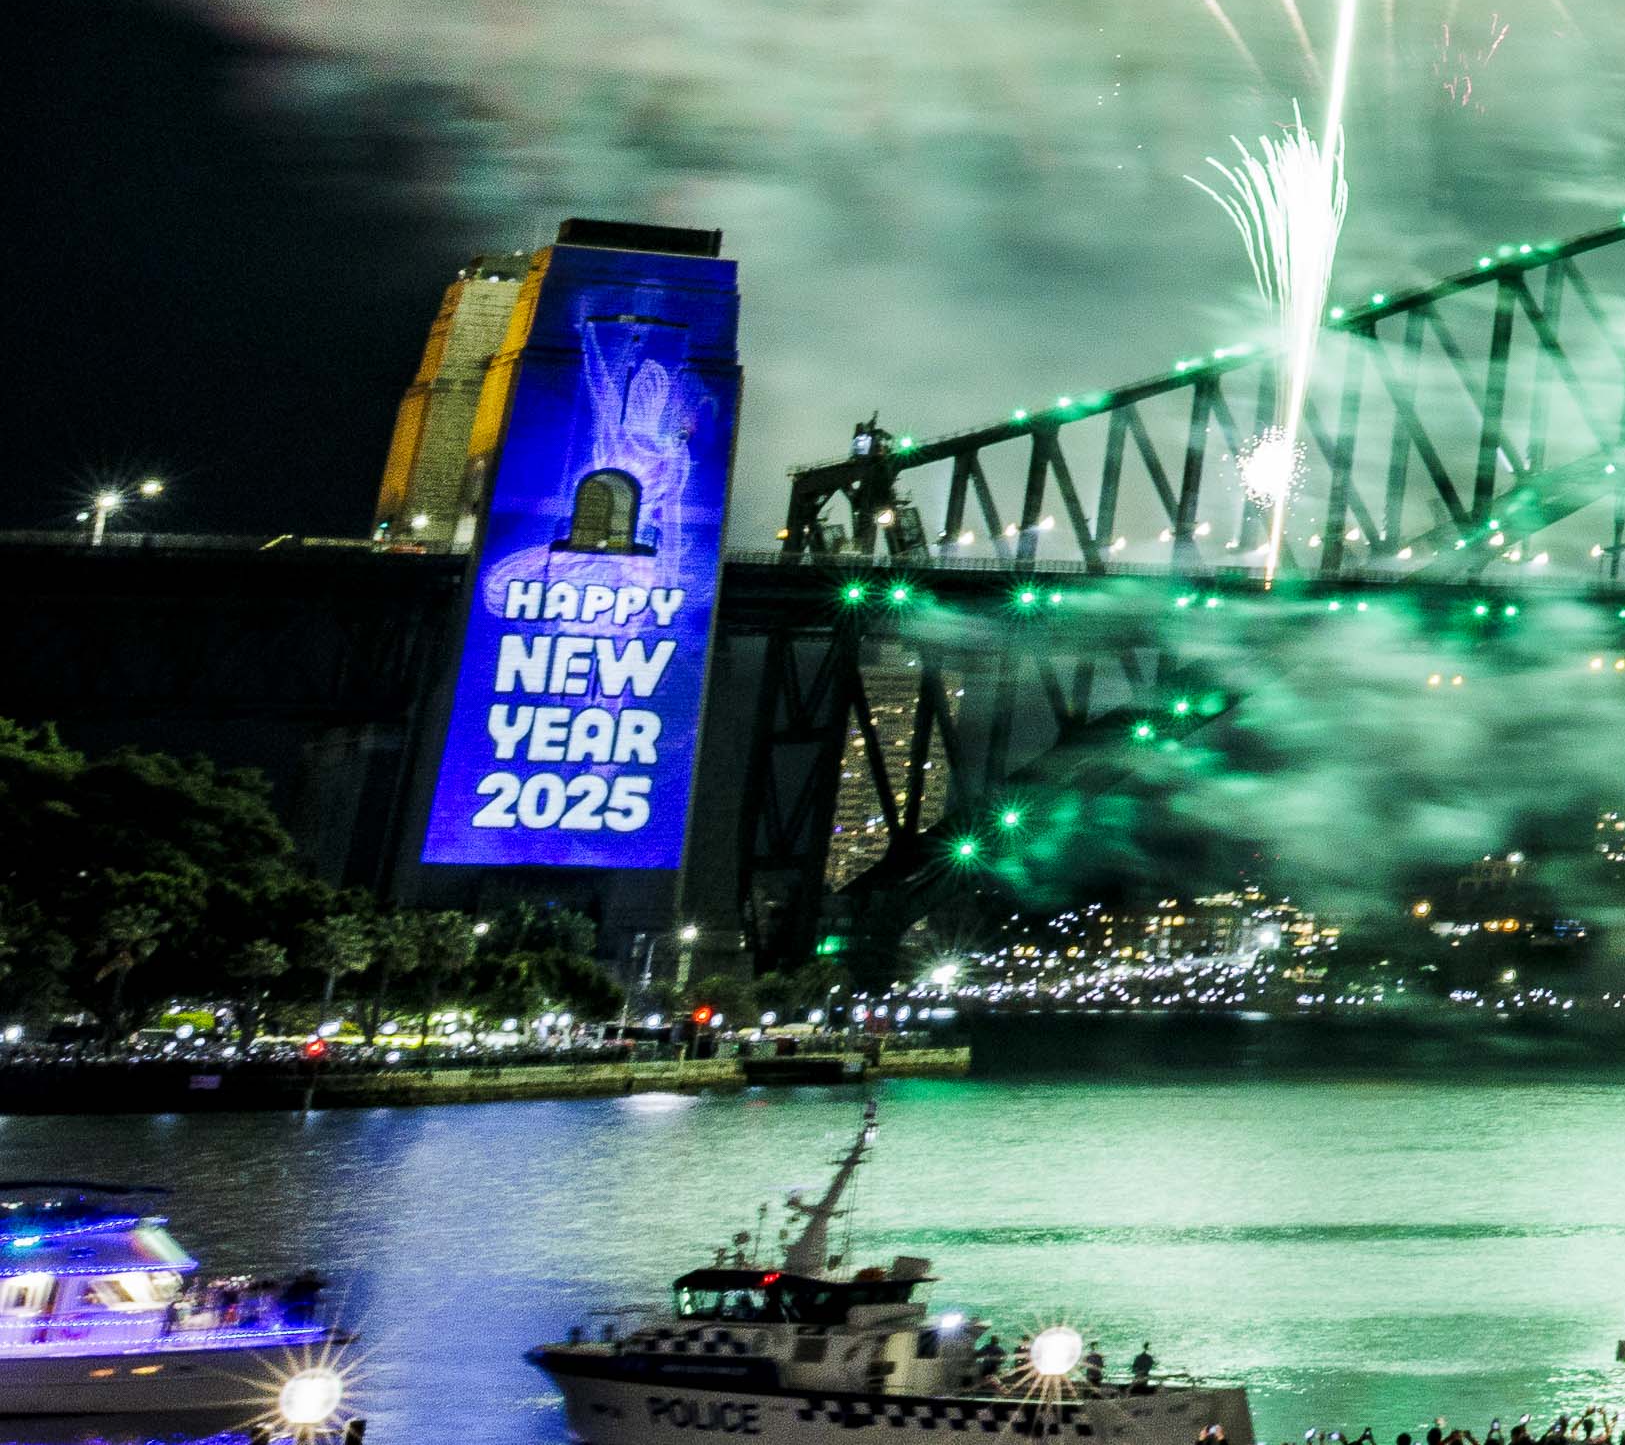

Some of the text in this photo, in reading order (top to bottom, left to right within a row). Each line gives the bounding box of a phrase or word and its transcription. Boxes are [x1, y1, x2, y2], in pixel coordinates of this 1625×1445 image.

[504, 580, 686, 626] HAPPY
[494, 634, 677, 698] NEW
[487, 703, 662, 764] YEAR
[471, 771, 653, 833] 2025
[647, 1396, 760, 1434] POLICE
